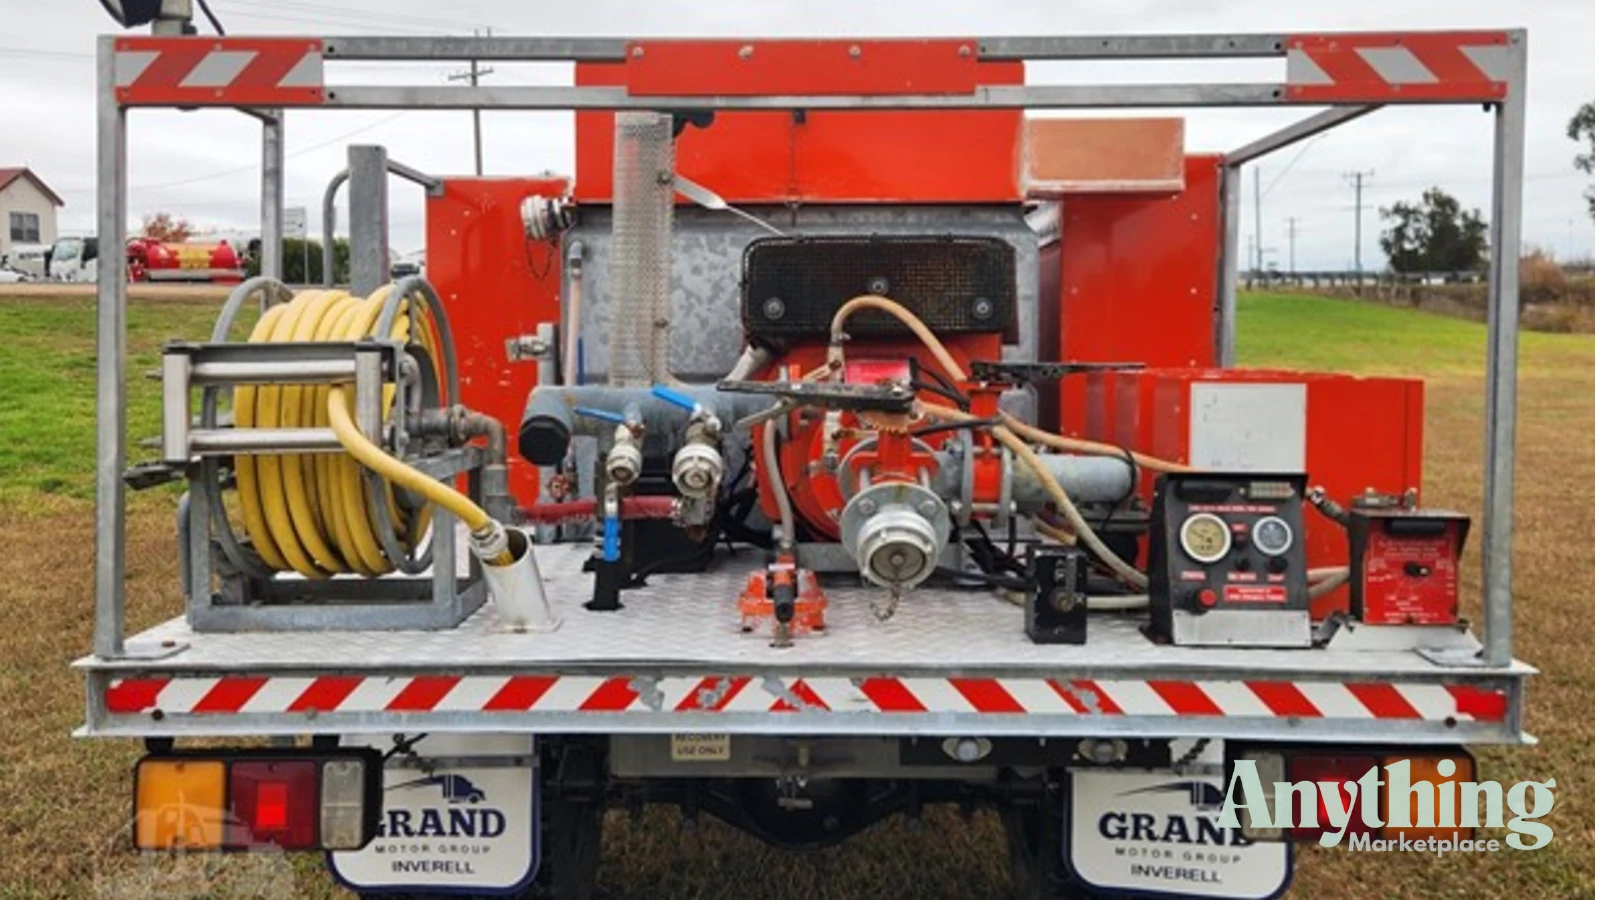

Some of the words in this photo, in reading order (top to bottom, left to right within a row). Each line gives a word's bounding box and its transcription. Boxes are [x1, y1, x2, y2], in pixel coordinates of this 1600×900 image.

[375, 844, 431, 854] MOTOR
[438, 844, 492, 854] GROUP
[1114, 846, 1174, 859] MOTOR
[1182, 851, 1242, 864] GROUP
[392, 860, 475, 875] INVERELL
[1130, 865, 1223, 884] INVERELL
